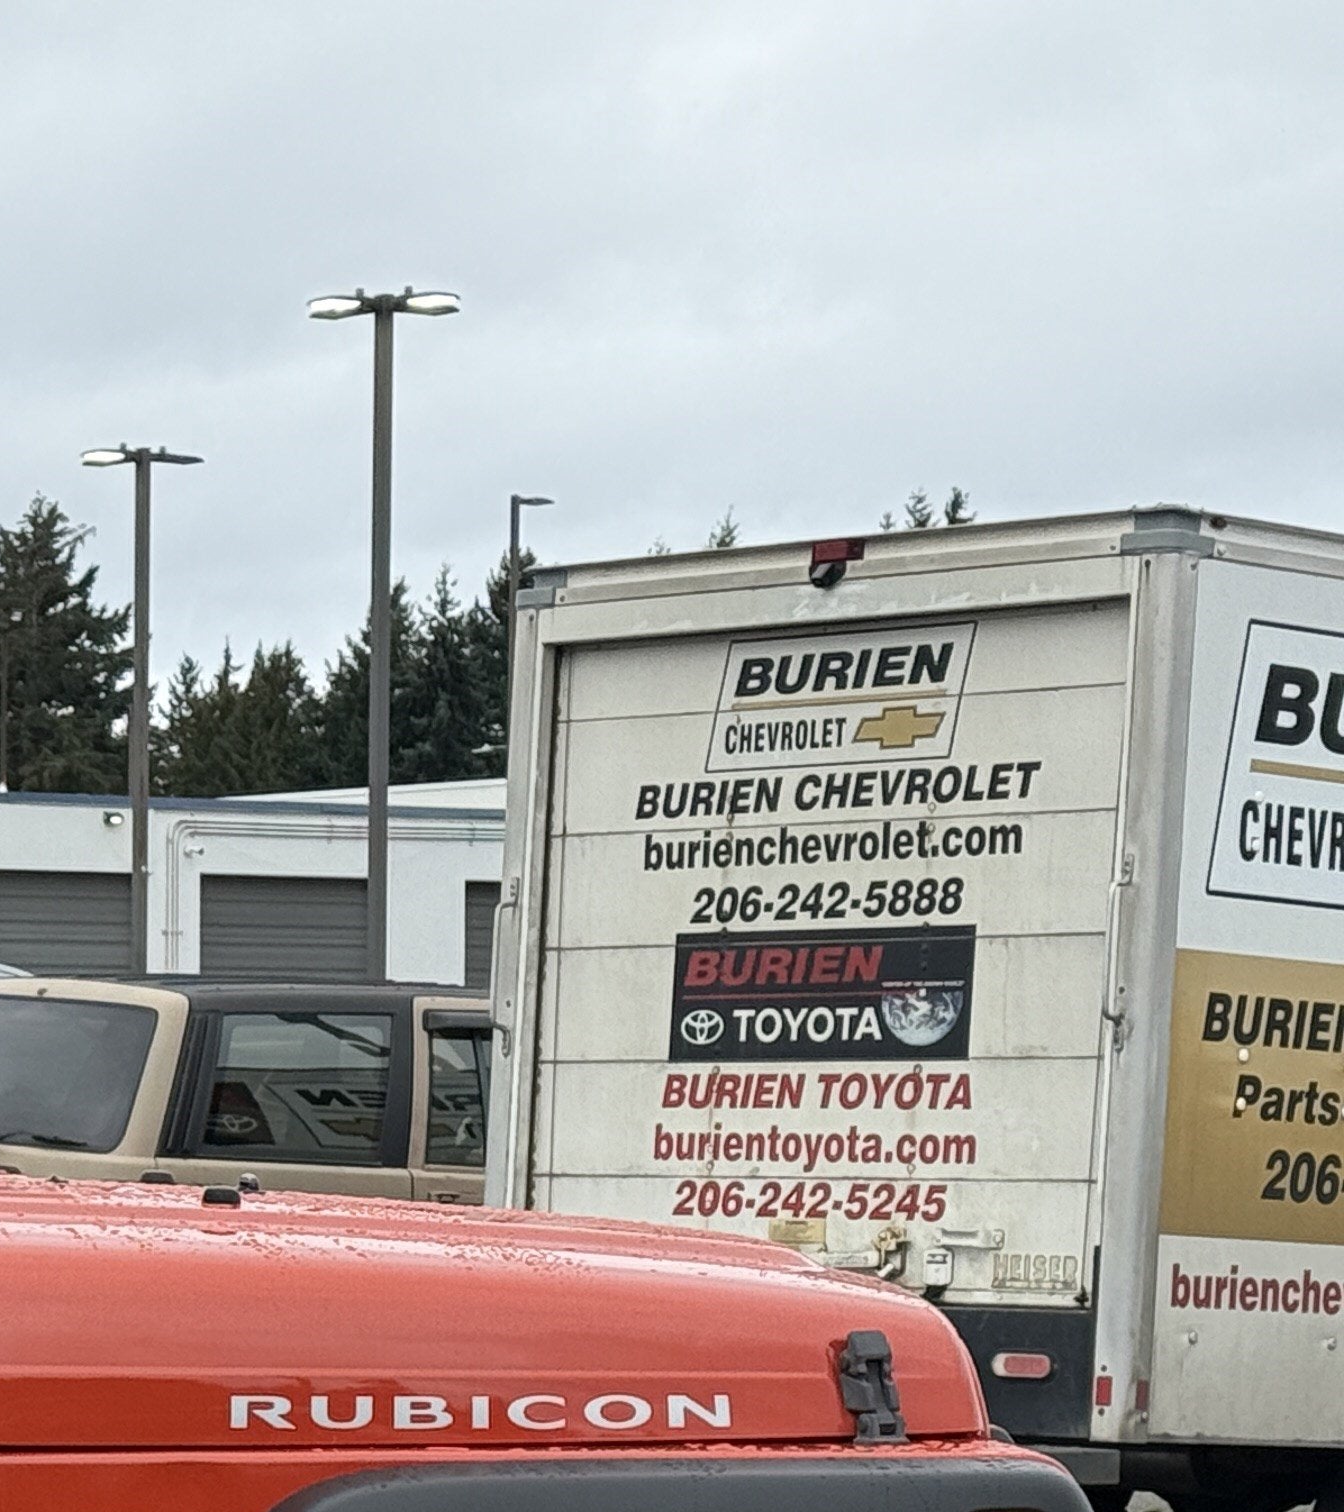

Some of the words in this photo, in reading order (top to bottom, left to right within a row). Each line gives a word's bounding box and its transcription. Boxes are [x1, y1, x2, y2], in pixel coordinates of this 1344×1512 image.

[733, 641, 955, 698] BURIEN
[724, 717, 847, 756] CHEVROLET
[635, 775, 783, 820] BURIEN
[794, 761, 1042, 812] CHEVROLET
[643, 821, 1023, 871] burienchevrolet.com
[689, 876, 965, 925] 206-242-5888
[683, 945, 884, 987] BURIEN
[732, 1006, 883, 1043] TOYOTA
[661, 1072, 807, 1110] BURIEN
[816, 1072, 973, 1111] TOYOTA
[653, 1122, 977, 1173] burientoyota.com
[1260, 1148, 1344, 1206] 206
[671, 1179, 949, 1223] 206-242-5245
[992, 1253, 1079, 1290] HEISER
[1170, 1262, 1344, 1317] burienche
[229, 1393, 732, 1431] RUBICON
